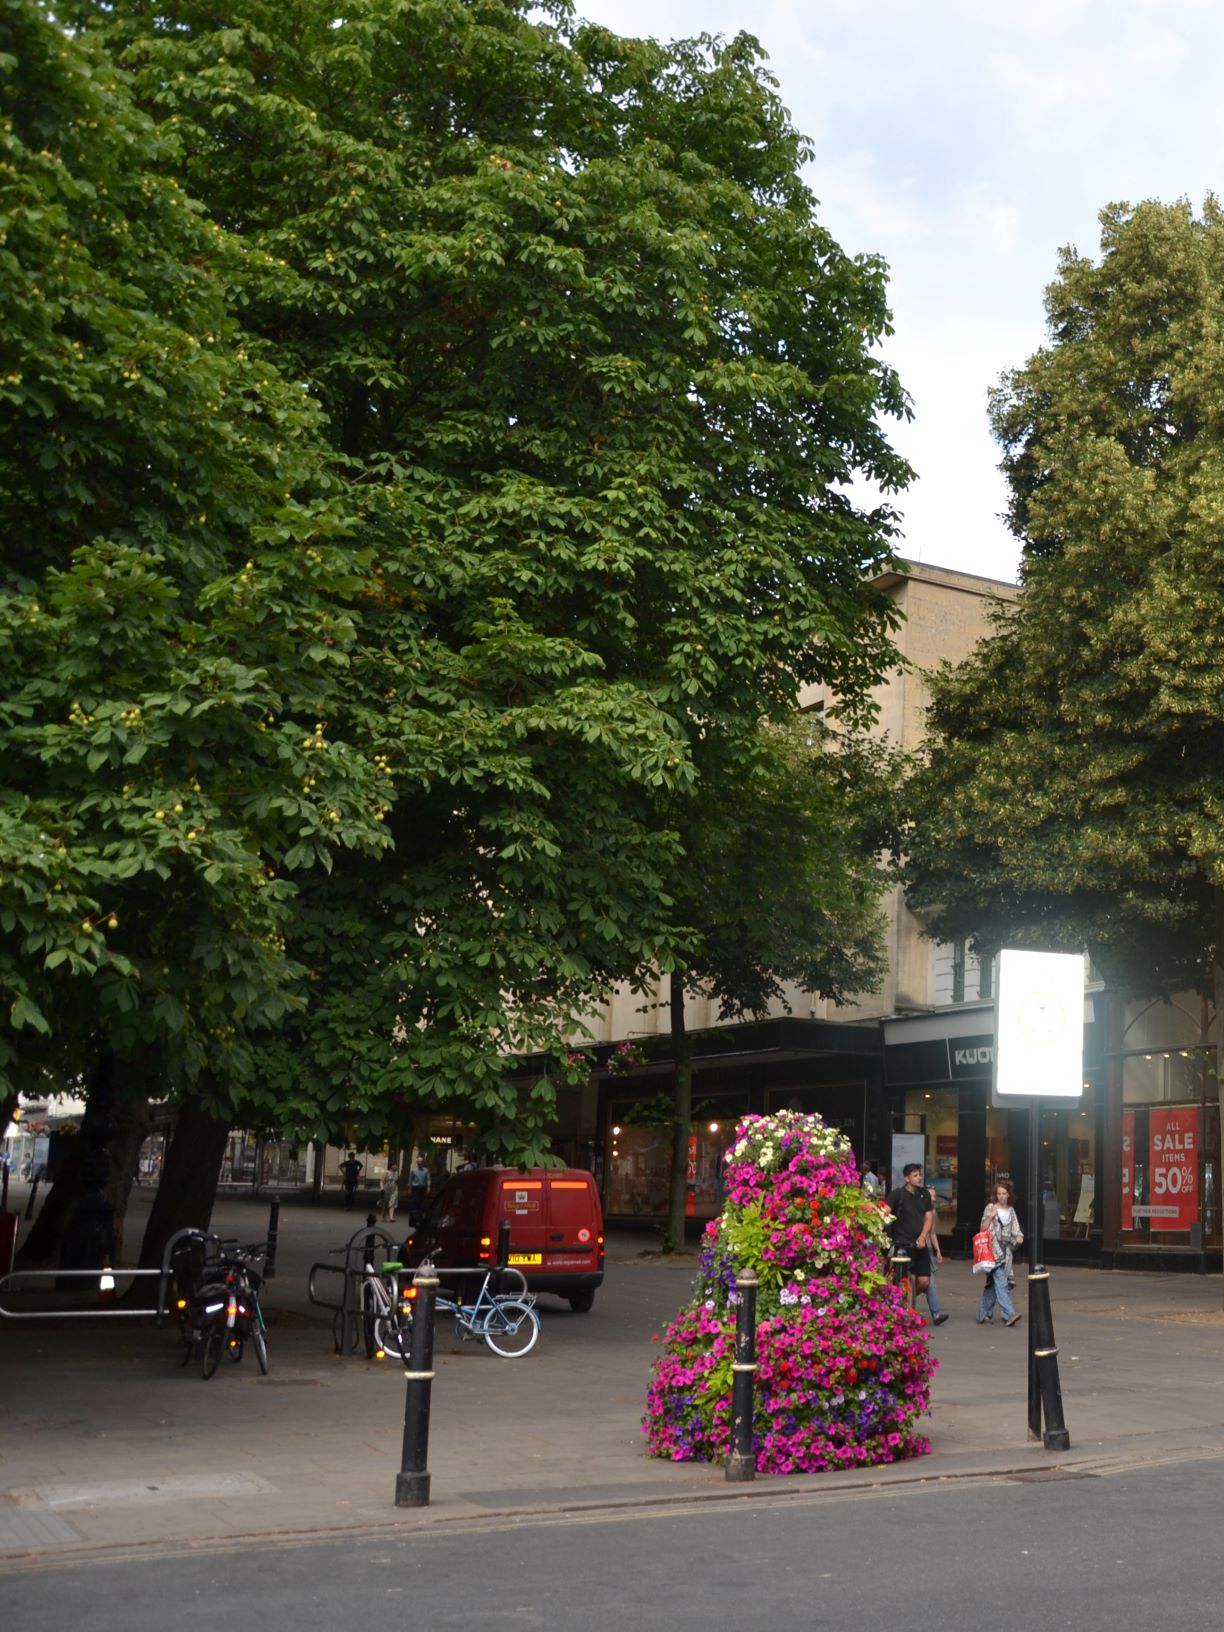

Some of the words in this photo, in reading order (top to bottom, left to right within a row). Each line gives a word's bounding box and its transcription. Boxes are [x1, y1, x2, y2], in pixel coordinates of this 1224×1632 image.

[1166, 1121, 1181, 1131] ALL
[1153, 1133, 1194, 1151] SALE
[1162, 1153, 1185, 1163] ITEMS
[1181, 1185, 1194, 1193] OFF
